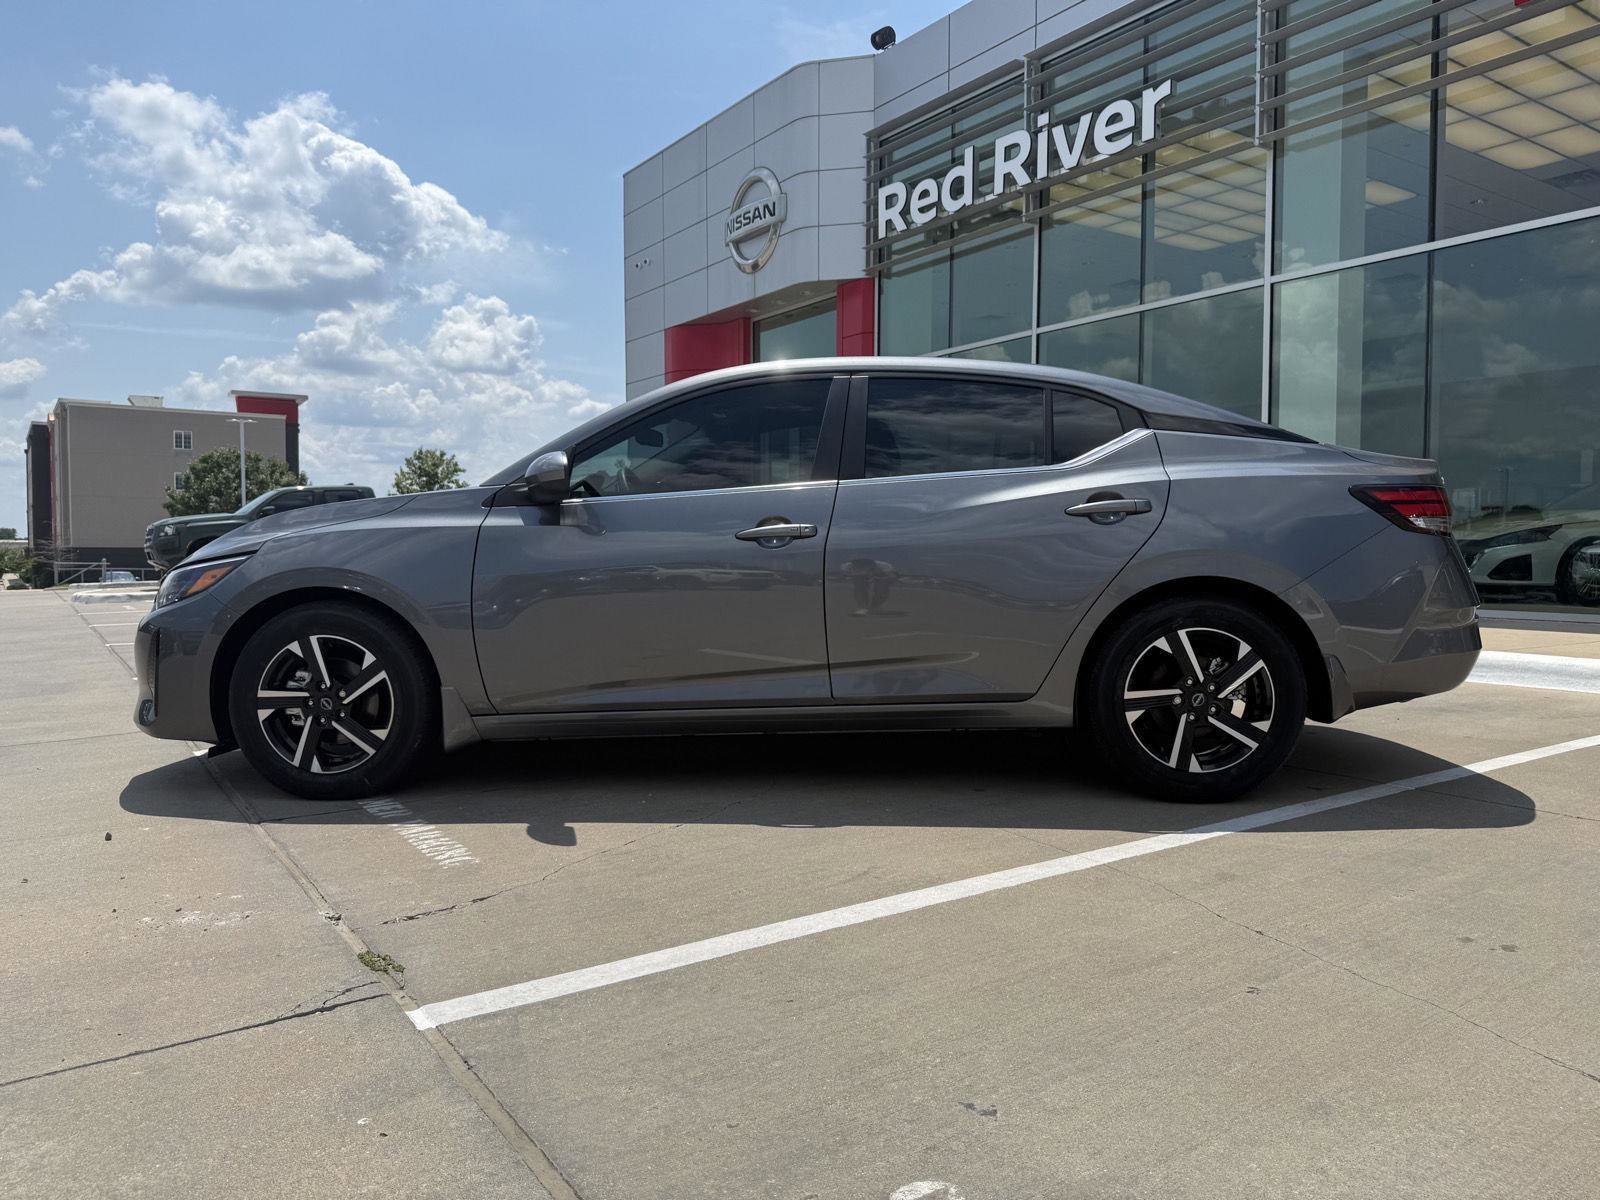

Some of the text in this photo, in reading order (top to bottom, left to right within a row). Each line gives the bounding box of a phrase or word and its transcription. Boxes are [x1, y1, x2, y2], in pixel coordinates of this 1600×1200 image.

[877, 80, 1173, 239] Red River
[725, 200, 776, 235] NISSAN
